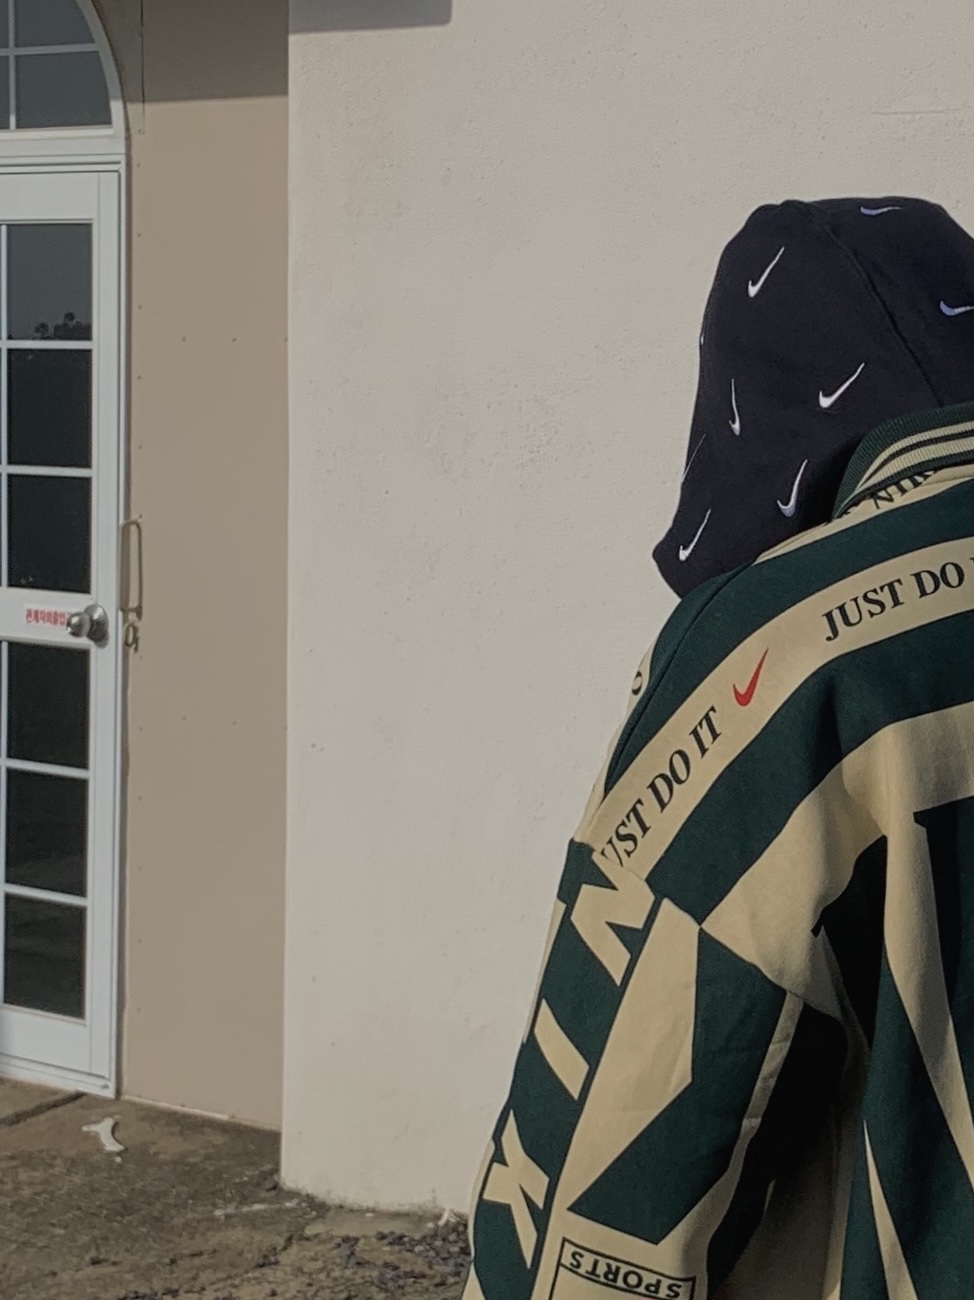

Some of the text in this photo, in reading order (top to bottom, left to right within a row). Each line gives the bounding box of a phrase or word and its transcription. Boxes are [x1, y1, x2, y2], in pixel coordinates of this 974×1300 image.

[821, 579, 906, 643] JUST
[910, 561, 966, 599] DO
[600, 704, 722, 868] UST DO IT
[568, 1250, 683, 1299] SPORTS
